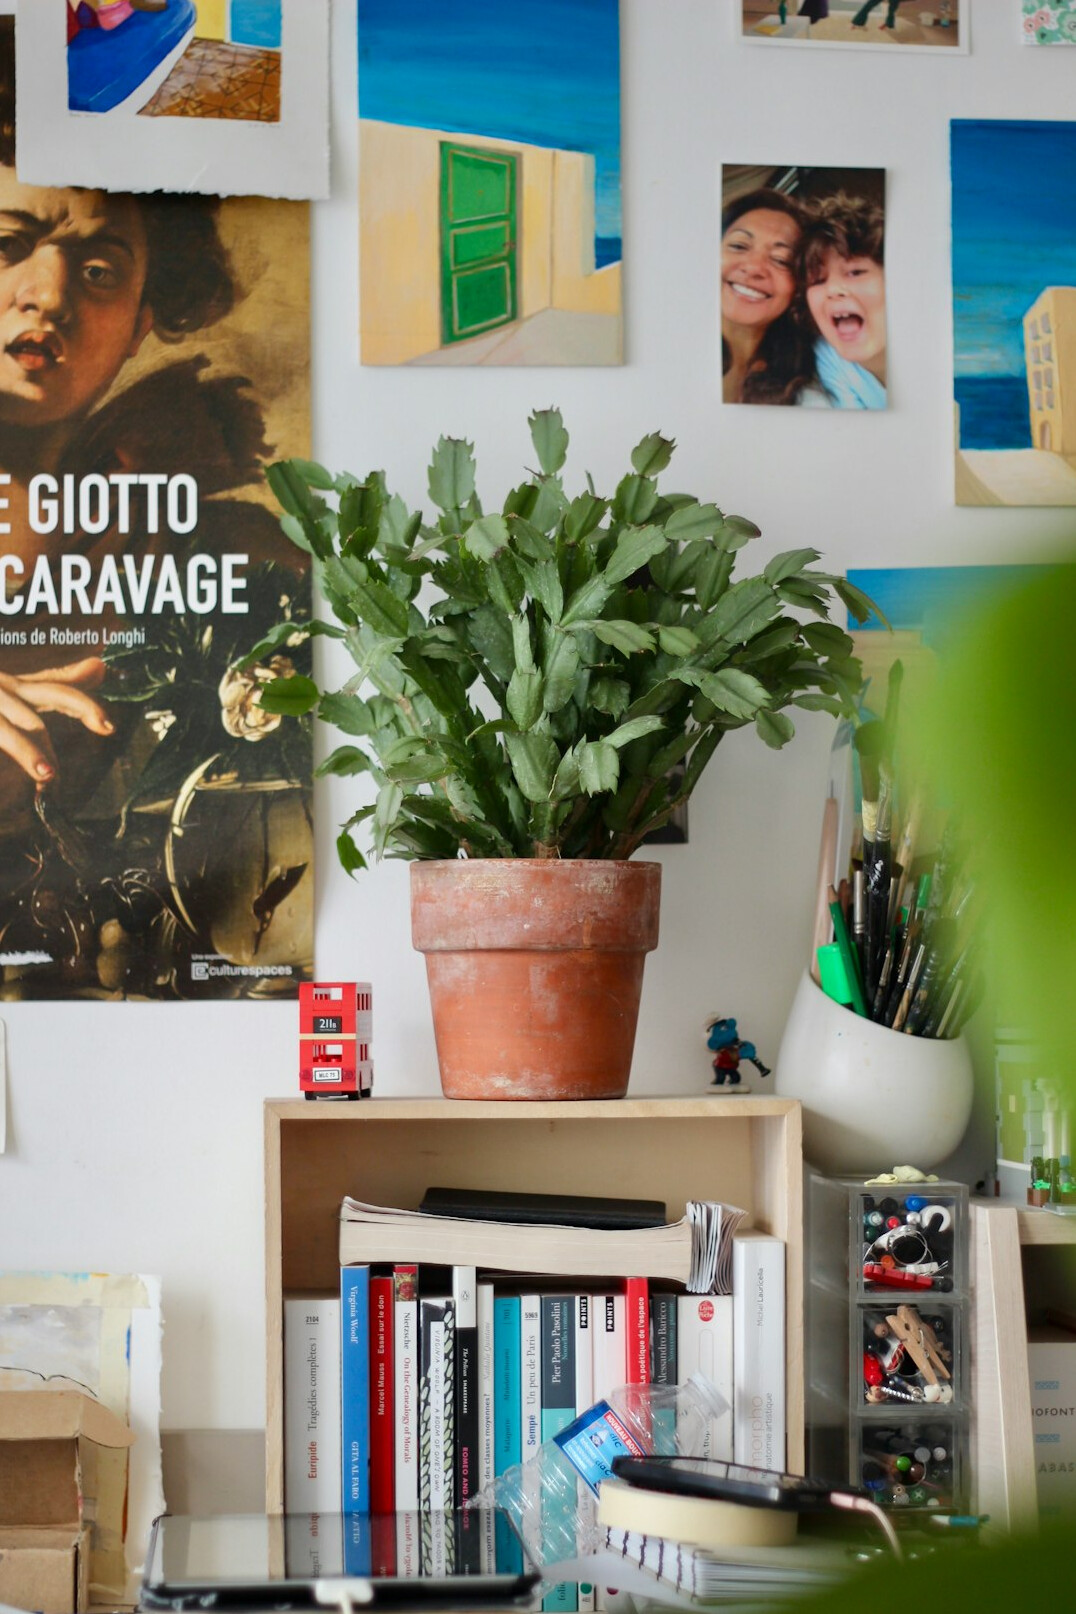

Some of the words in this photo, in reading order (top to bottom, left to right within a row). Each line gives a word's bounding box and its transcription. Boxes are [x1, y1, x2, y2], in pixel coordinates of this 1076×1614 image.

[28, 473, 198, 534] GIOTTO
[0, 553, 249, 615] CARAVAGE
[30, 627, 46, 645] de
[50, 627, 99, 645] Roberto
[102, 627, 146, 648] Longhi
[208, 964, 293, 977] culturespaces
[756, 1268, 764, 1303] Lauricella
[348, 1285, 358, 1317] Virginia
[377, 1295, 385, 1310] don
[637, 1296, 646, 1328] l'espace
[377, 1310, 385, 1319] le
[552, 1302, 561, 1336] Pasolini
[606, 1302, 614, 1330] POINTS
[657, 1302, 667, 1335] Baricco
[756, 1303, 764, 1327] Michel
[350, 1319, 359, 1344] Woolf
[404, 1312, 412, 1349] Nietzsche
[638, 1329, 645, 1339] de
[527, 1335, 536, 1357] Paris
[552, 1337, 561, 1363] Paolo
[637, 1340, 647, 1374] poétique
[307, 1343, 319, 1387] complètes
[404, 1357, 412, 1369] On
[526, 1359, 536, 1370] de
[657, 1337, 667, 1384] Alessandro
[403, 1370, 412, 1384] the
[529, 1371, 538, 1388] peu
[552, 1366, 561, 1383] Pier
[638, 1375, 646, 1384] La
[307, 1389, 319, 1432] Tragédies
[402, 1384, 412, 1425] Genealogy
[527, 1394, 536, 1405] Un
[764, 1392, 773, 1432] artistique
[403, 1426, 412, 1437] of
[433, 1415, 441, 1437] ROOM
[527, 1415, 538, 1446] Sempé
[606, 1414, 628, 1440] NOUVEAU
[351, 1441, 359, 1461] GITA
[403, 1437, 412, 1463] Morals
[433, 1439, 441, 1449] OF
[308, 1441, 319, 1479] Euripide
[351, 1463, 359, 1476] AL
[351, 1477, 359, 1499] FARO
[433, 1473, 441, 1492] OWN
